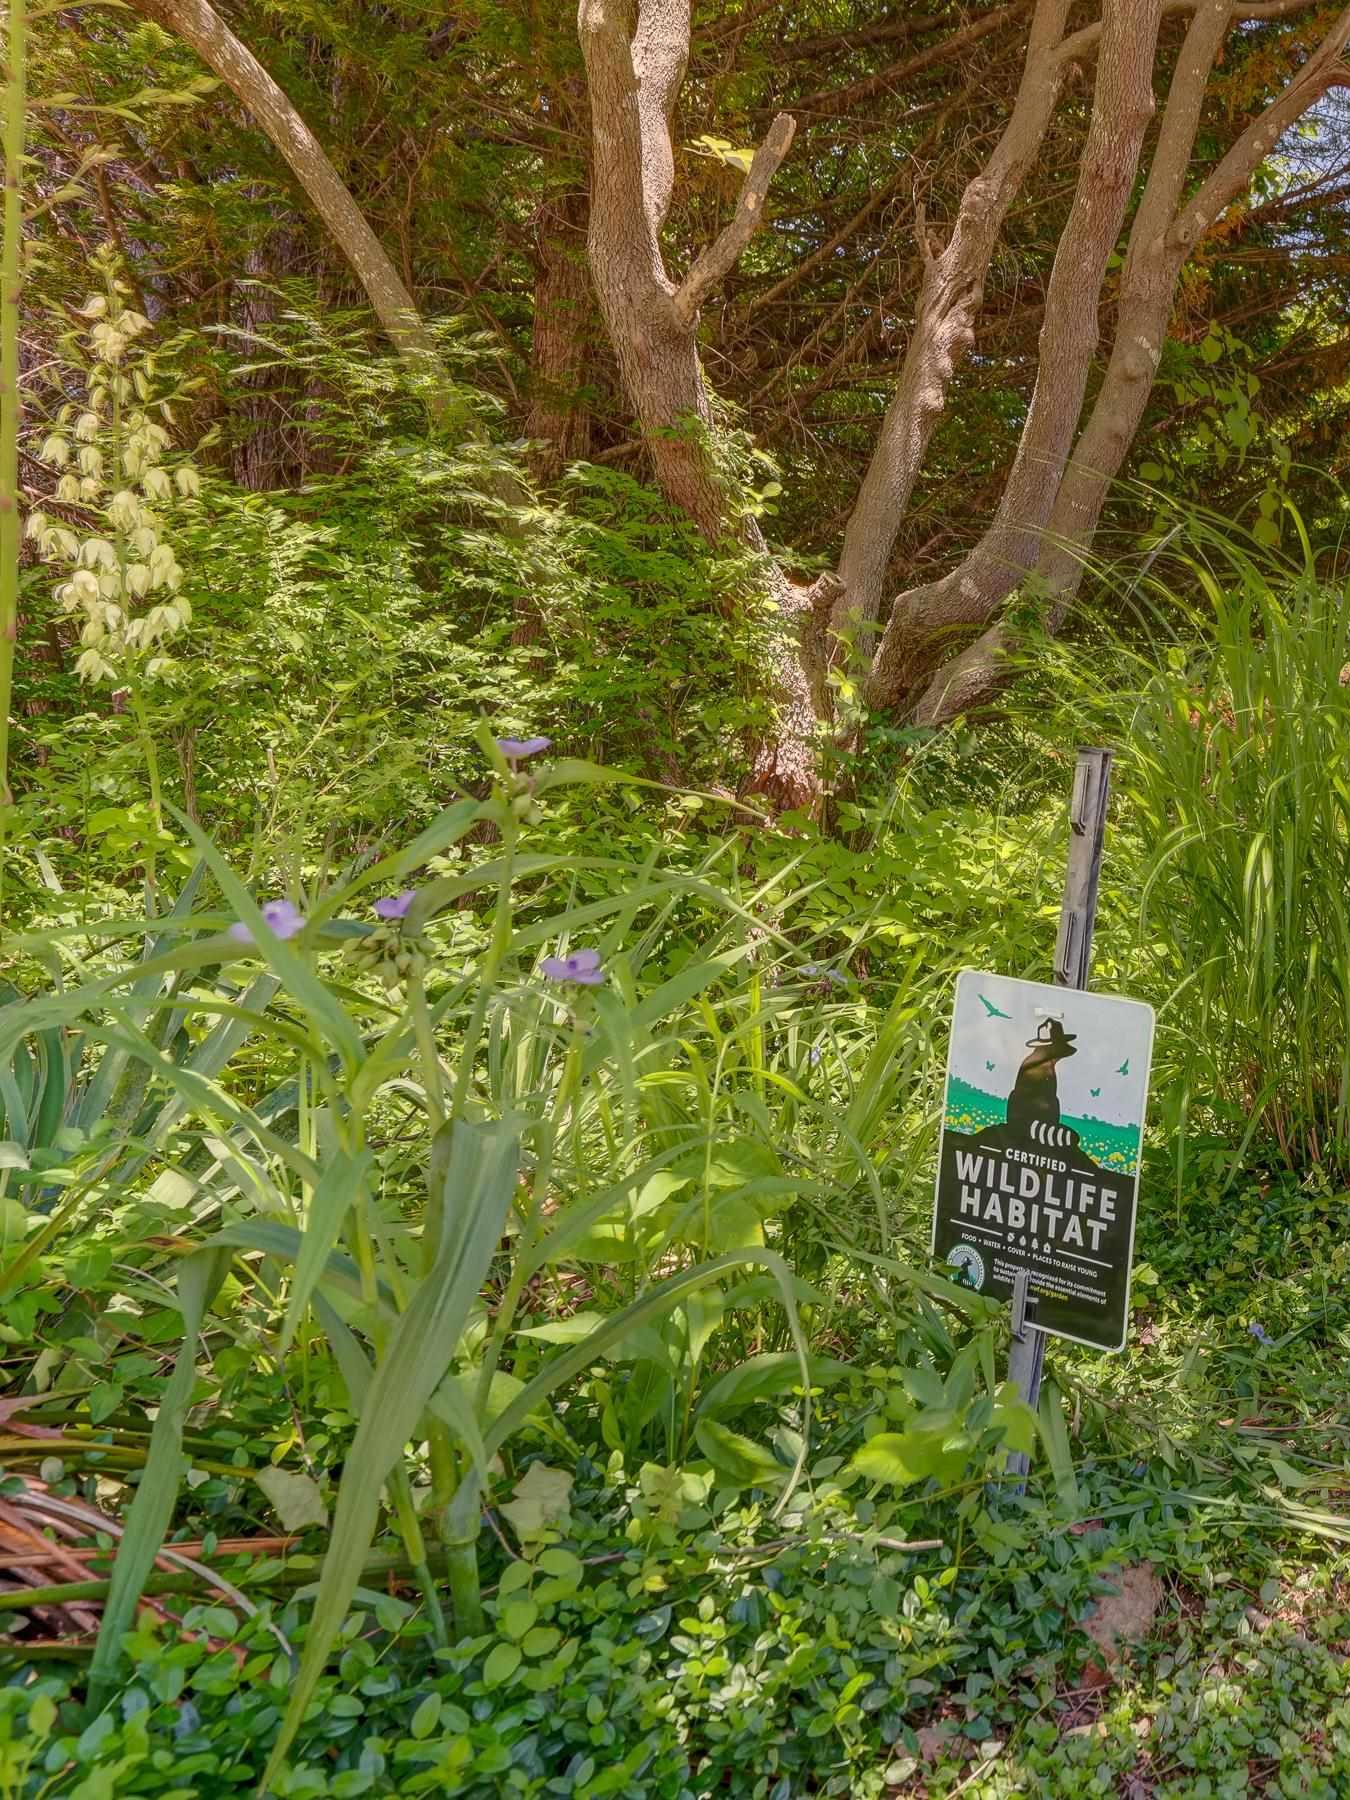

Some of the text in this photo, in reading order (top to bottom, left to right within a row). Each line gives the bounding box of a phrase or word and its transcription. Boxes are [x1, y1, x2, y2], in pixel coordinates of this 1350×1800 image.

[955, 1150, 1118, 1221] WILDLIFE
[1005, 1148, 1067, 1173] CERTIFIED
[959, 1184, 1108, 1251] HABITAT
[961, 1232, 1098, 1278] FOOD WATER COVER PLACES TO RAISE YOUNG
